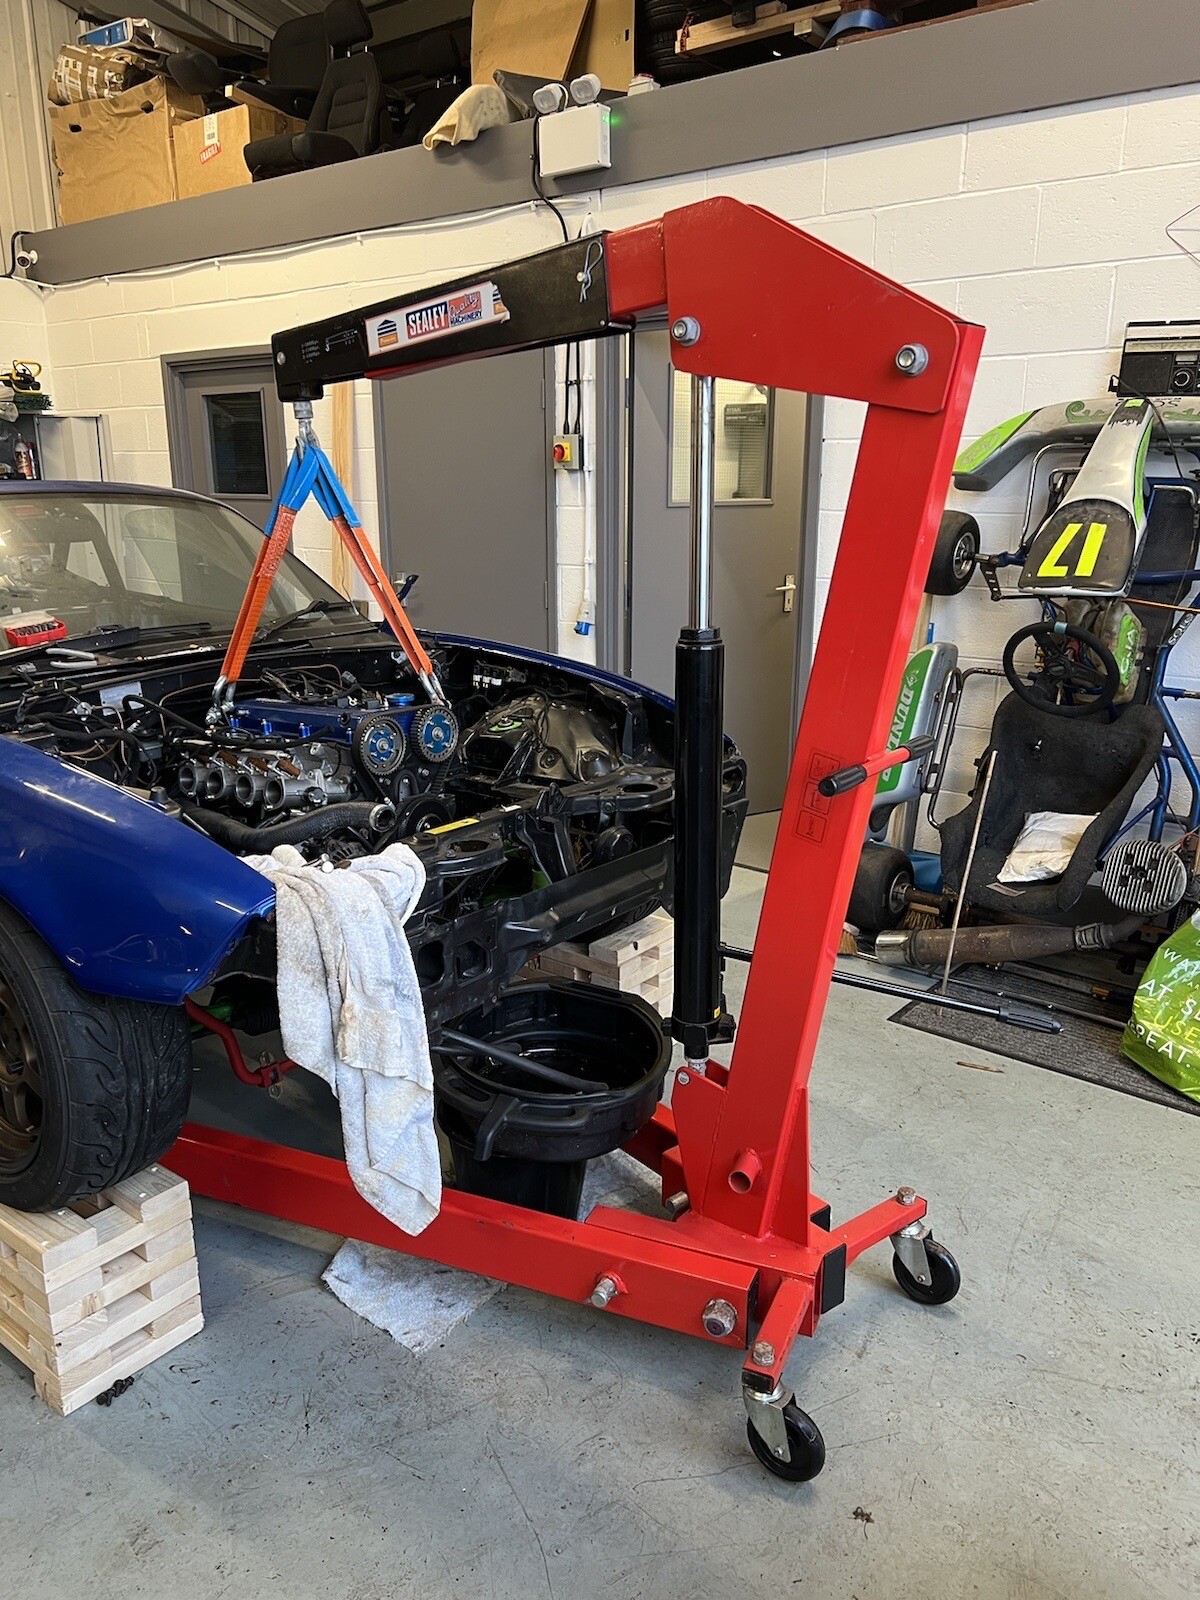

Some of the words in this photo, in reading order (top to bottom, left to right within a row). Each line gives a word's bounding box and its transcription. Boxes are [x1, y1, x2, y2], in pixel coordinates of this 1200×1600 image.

[408, 304, 447, 336] SEALEY
[1036, 522, 1107, 577] 17
[1168, 613, 1194, 646] SOLO
[882, 685, 914, 782] DUNLP
